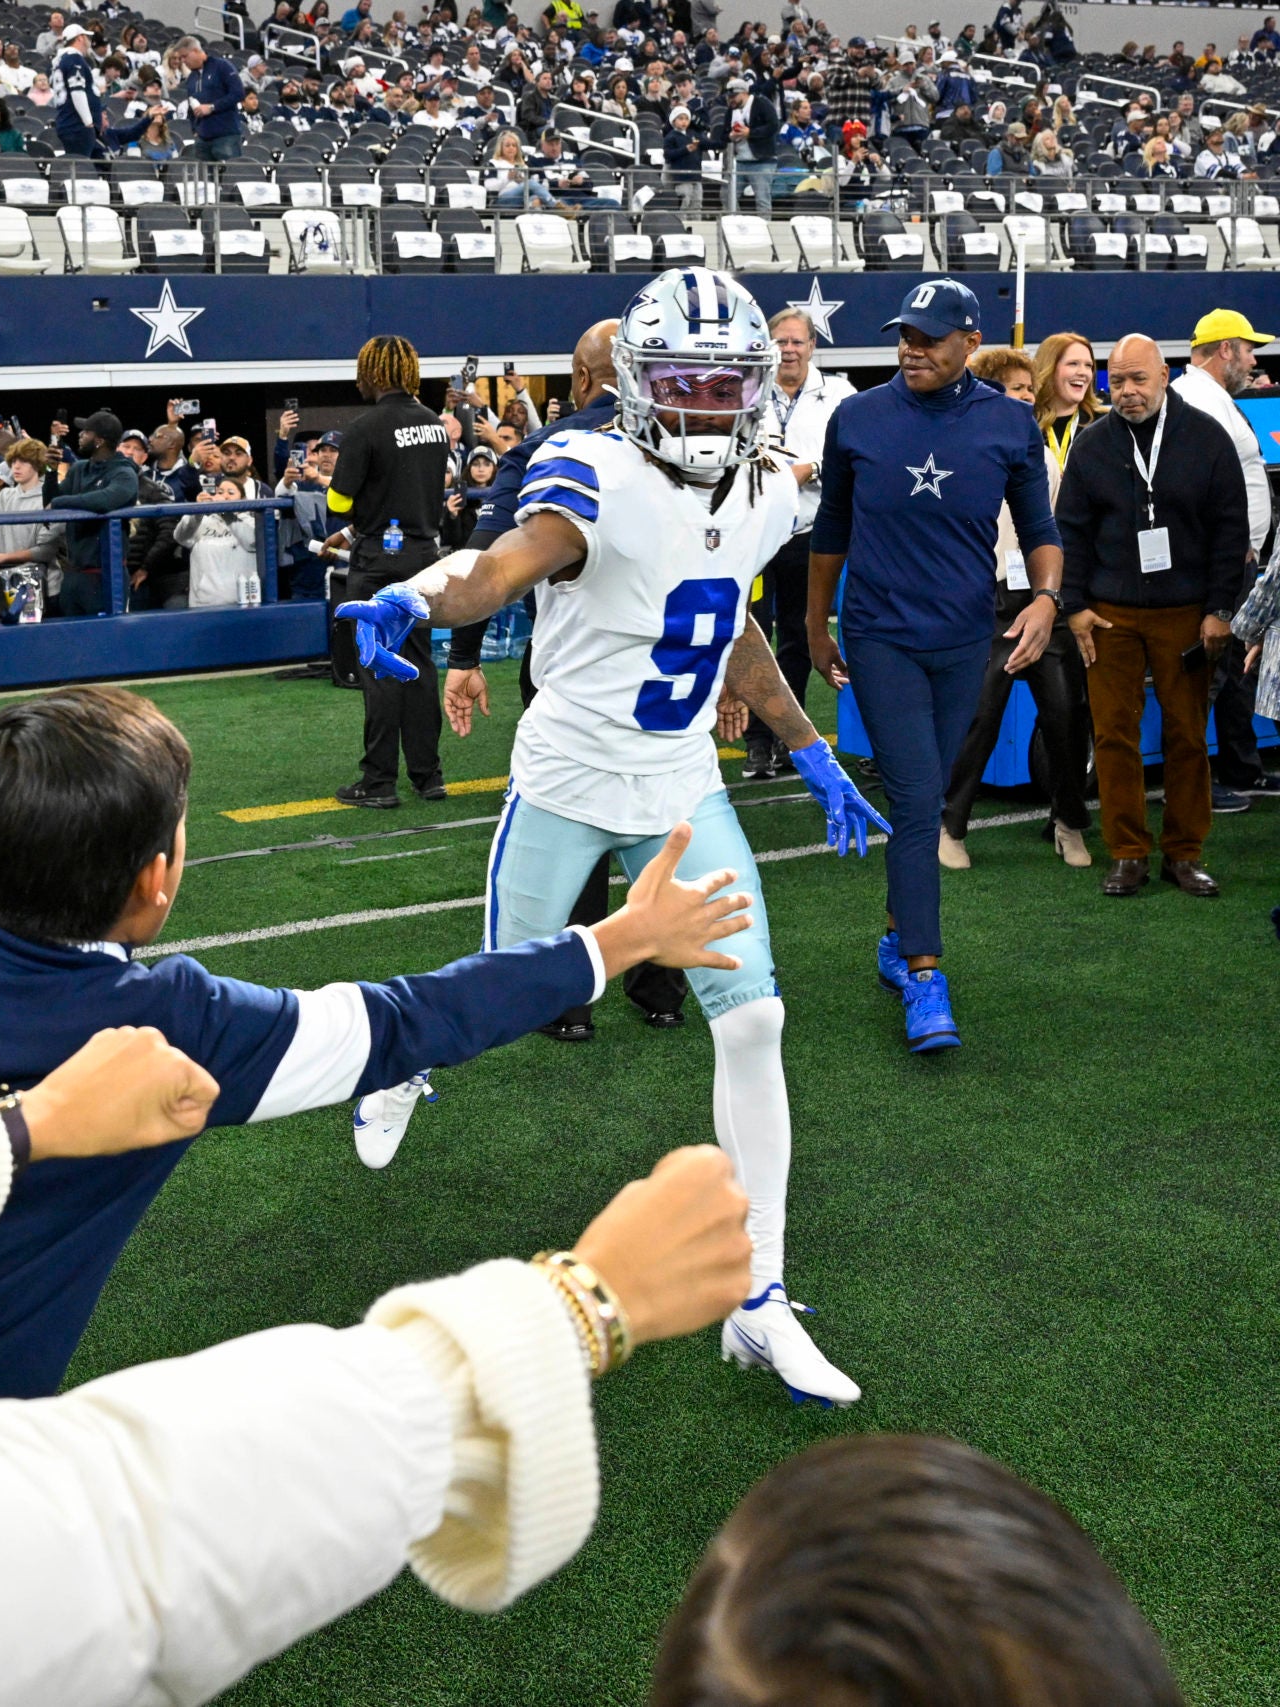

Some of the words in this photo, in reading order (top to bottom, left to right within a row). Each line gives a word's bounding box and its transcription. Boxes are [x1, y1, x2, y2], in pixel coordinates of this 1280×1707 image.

[911, 286, 936, 309] D
[694, 341, 728, 349] COWBOYS
[394, 424, 447, 448] SECURITY
[632, 577, 741, 731] 9
